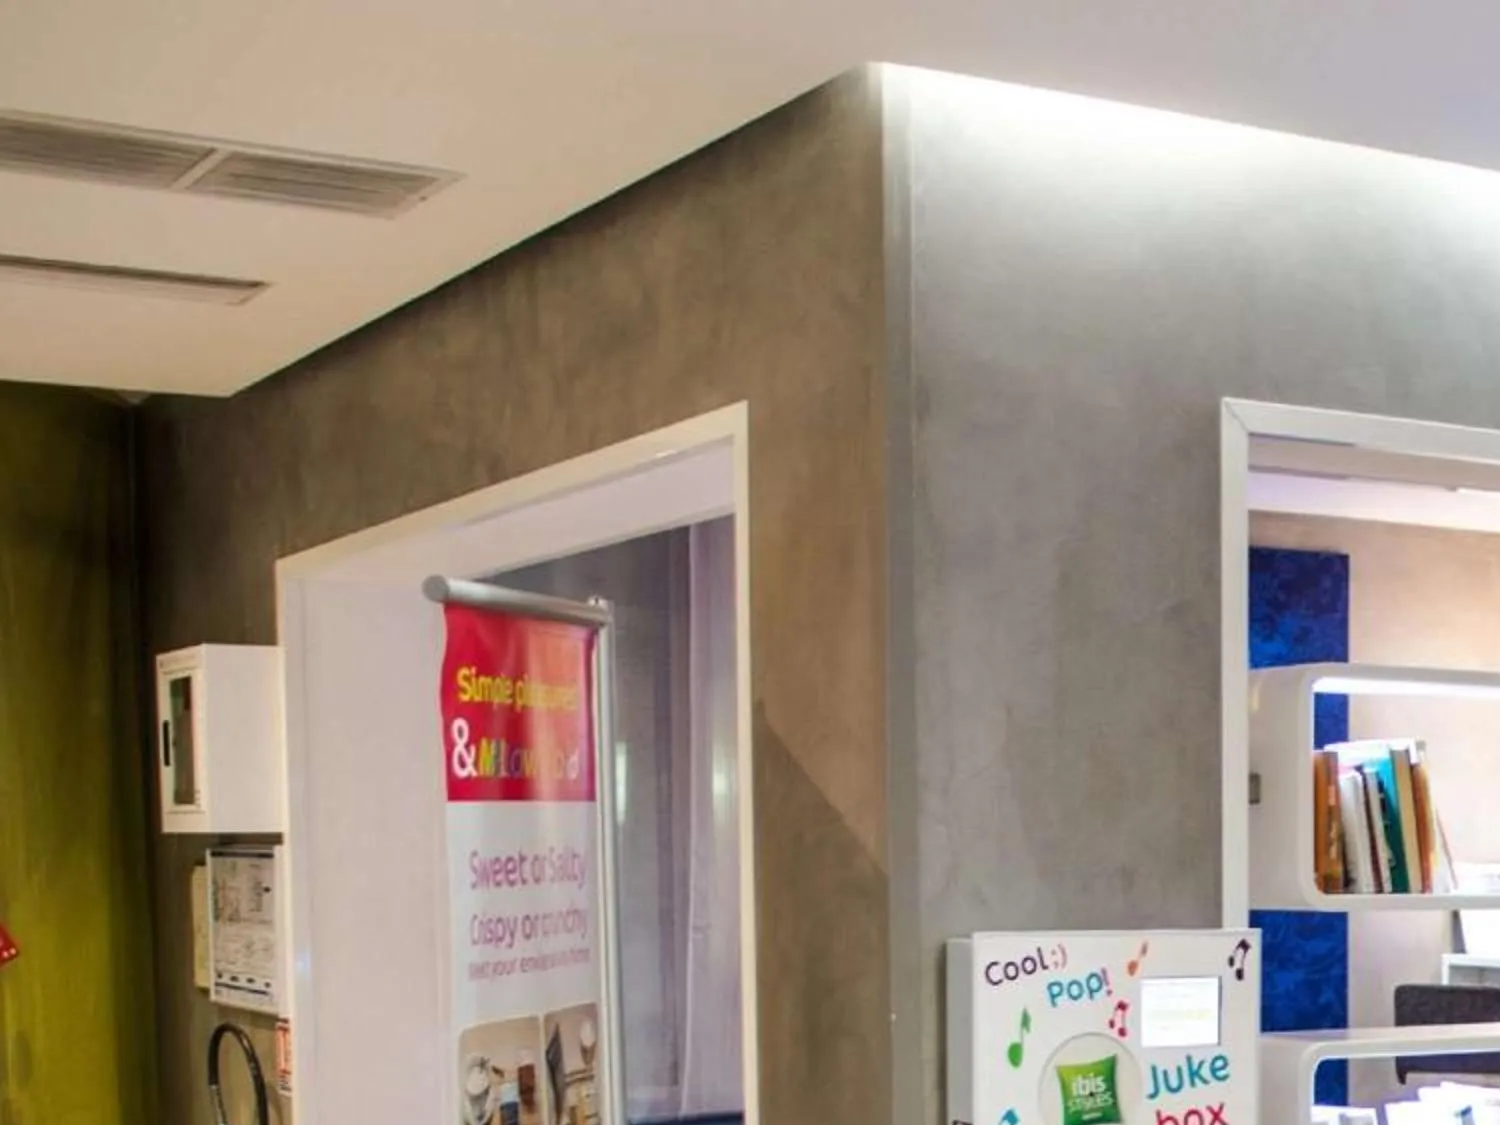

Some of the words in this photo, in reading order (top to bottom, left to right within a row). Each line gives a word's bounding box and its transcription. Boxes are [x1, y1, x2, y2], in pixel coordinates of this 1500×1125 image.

[451, 717, 478, 780] &
[469, 849, 527, 890] Sweet
[983, 945, 1049, 987] Cool
[1146, 1052, 1231, 1100] Juke
